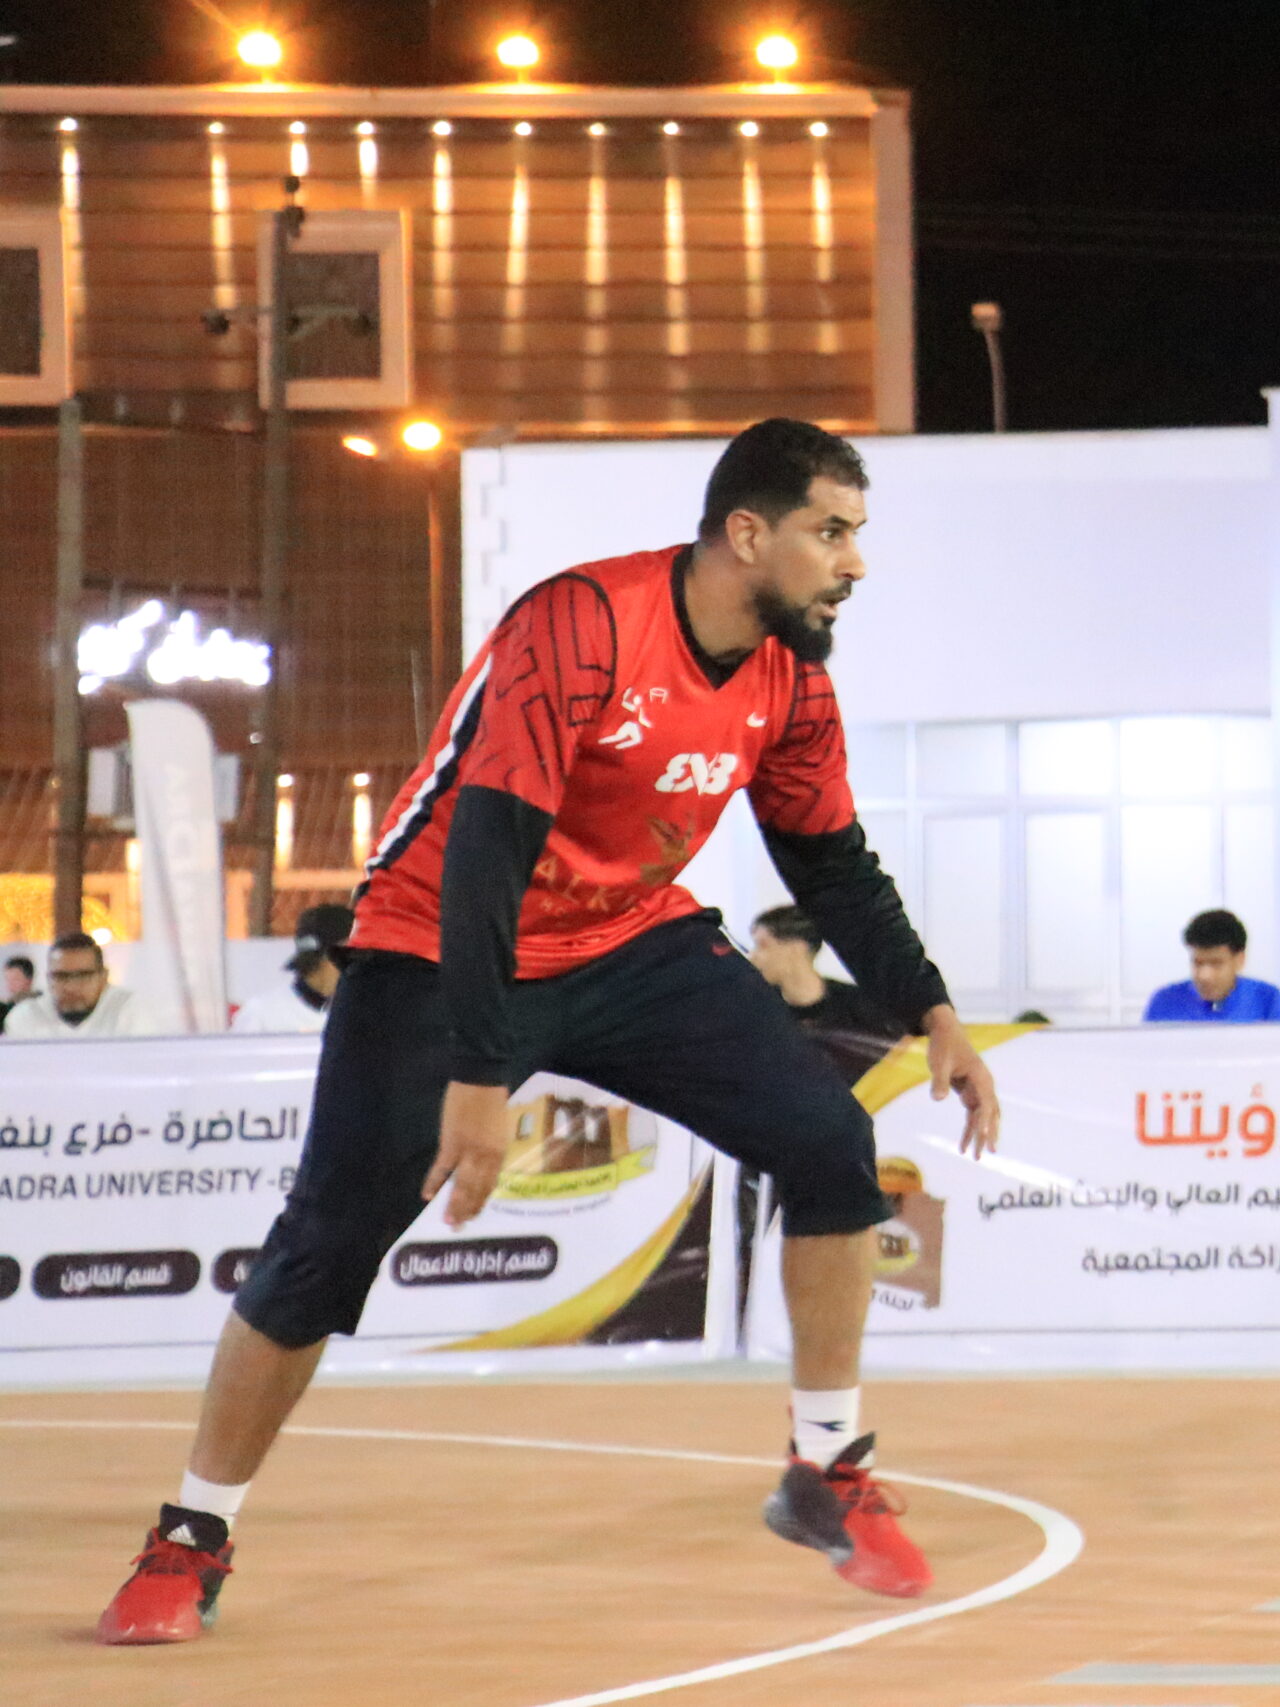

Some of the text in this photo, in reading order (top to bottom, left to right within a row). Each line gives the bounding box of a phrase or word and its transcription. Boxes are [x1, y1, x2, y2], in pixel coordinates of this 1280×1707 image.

[0, 1115, 52, 1157] بنغ
[161, 1107, 299, 1151] الحاضرة
[0, 1174, 77, 1200] ADRA
[85, 1167, 263, 1199] UNIVERSITY
[1166, 1182, 1240, 1216] العالي
[1081, 1246, 1219, 1278] المجتمعية
